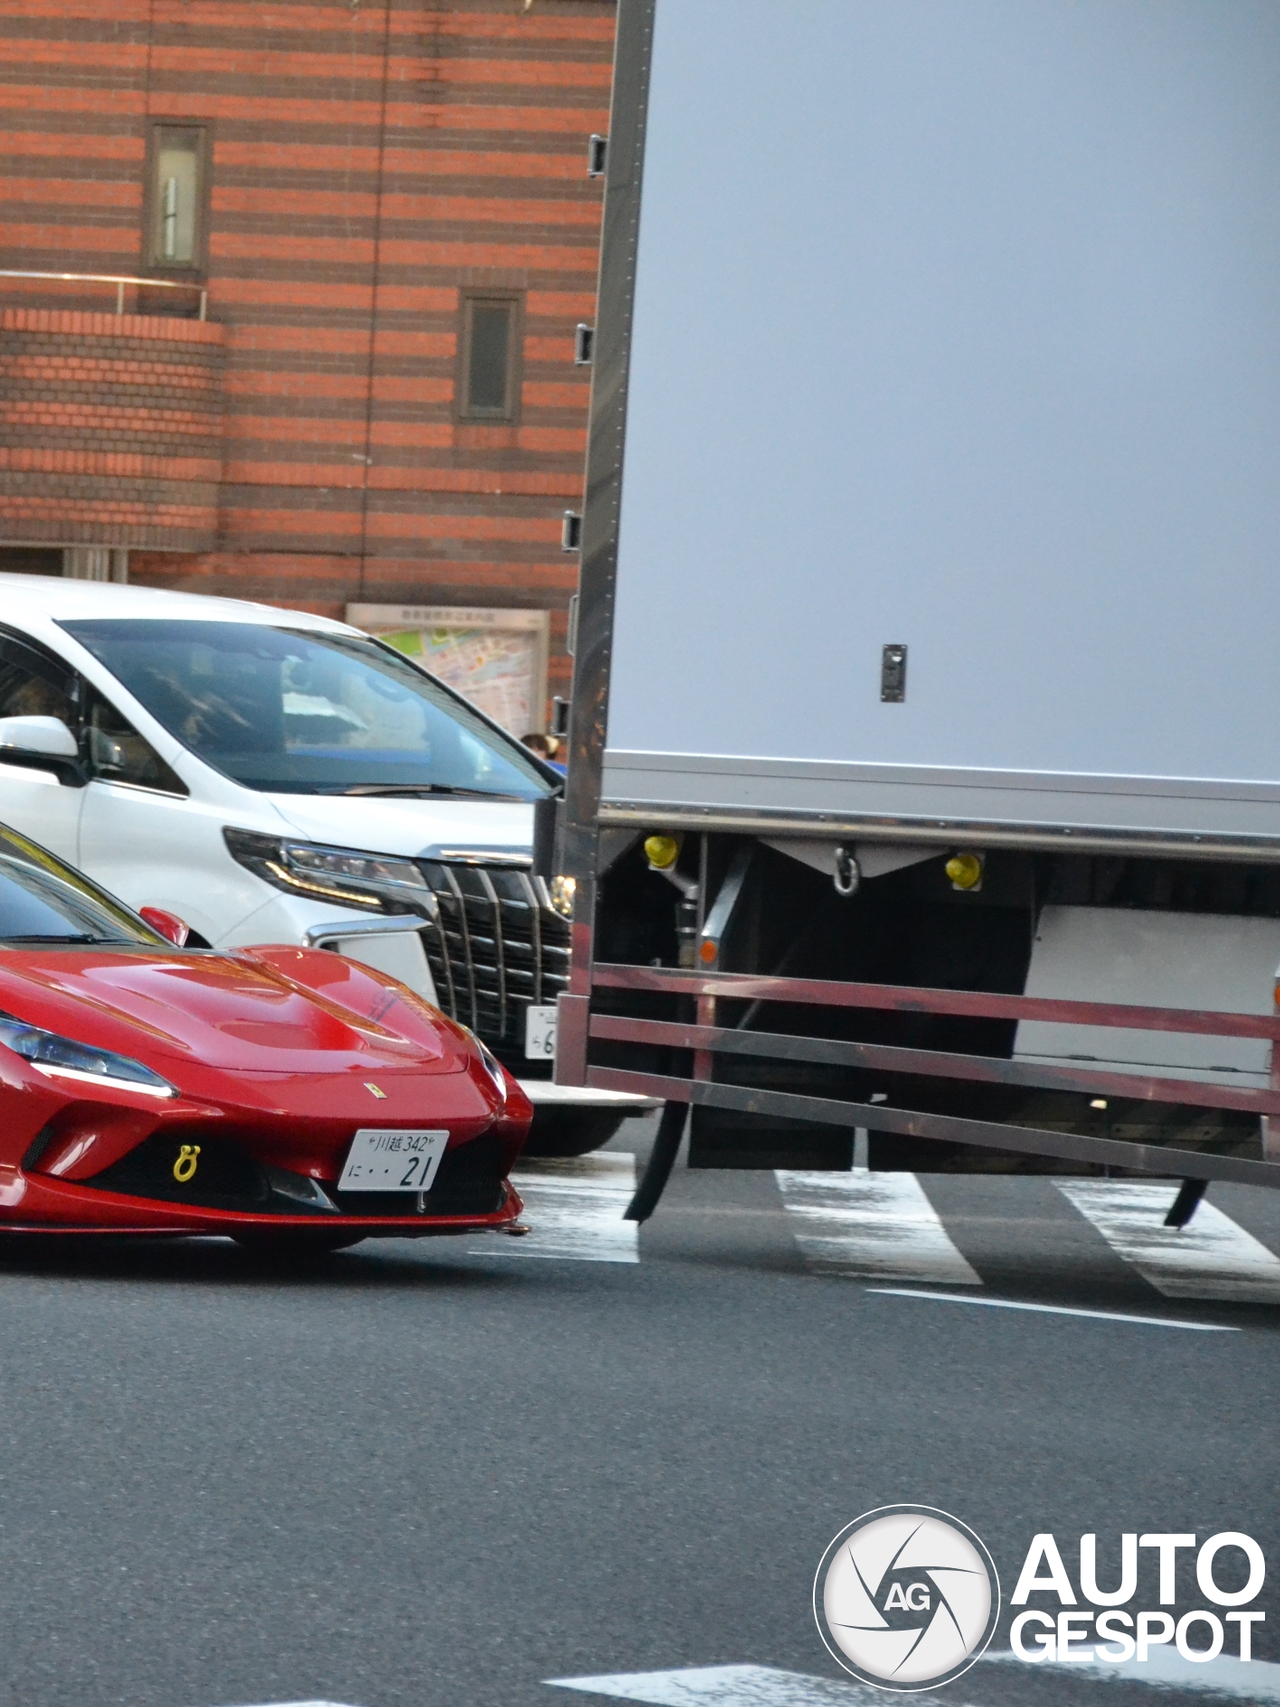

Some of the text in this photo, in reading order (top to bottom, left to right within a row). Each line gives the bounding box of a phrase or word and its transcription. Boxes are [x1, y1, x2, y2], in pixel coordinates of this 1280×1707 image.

[374, 1136, 429, 1152] 川越 342
[348, 1165, 362, 1178] に
